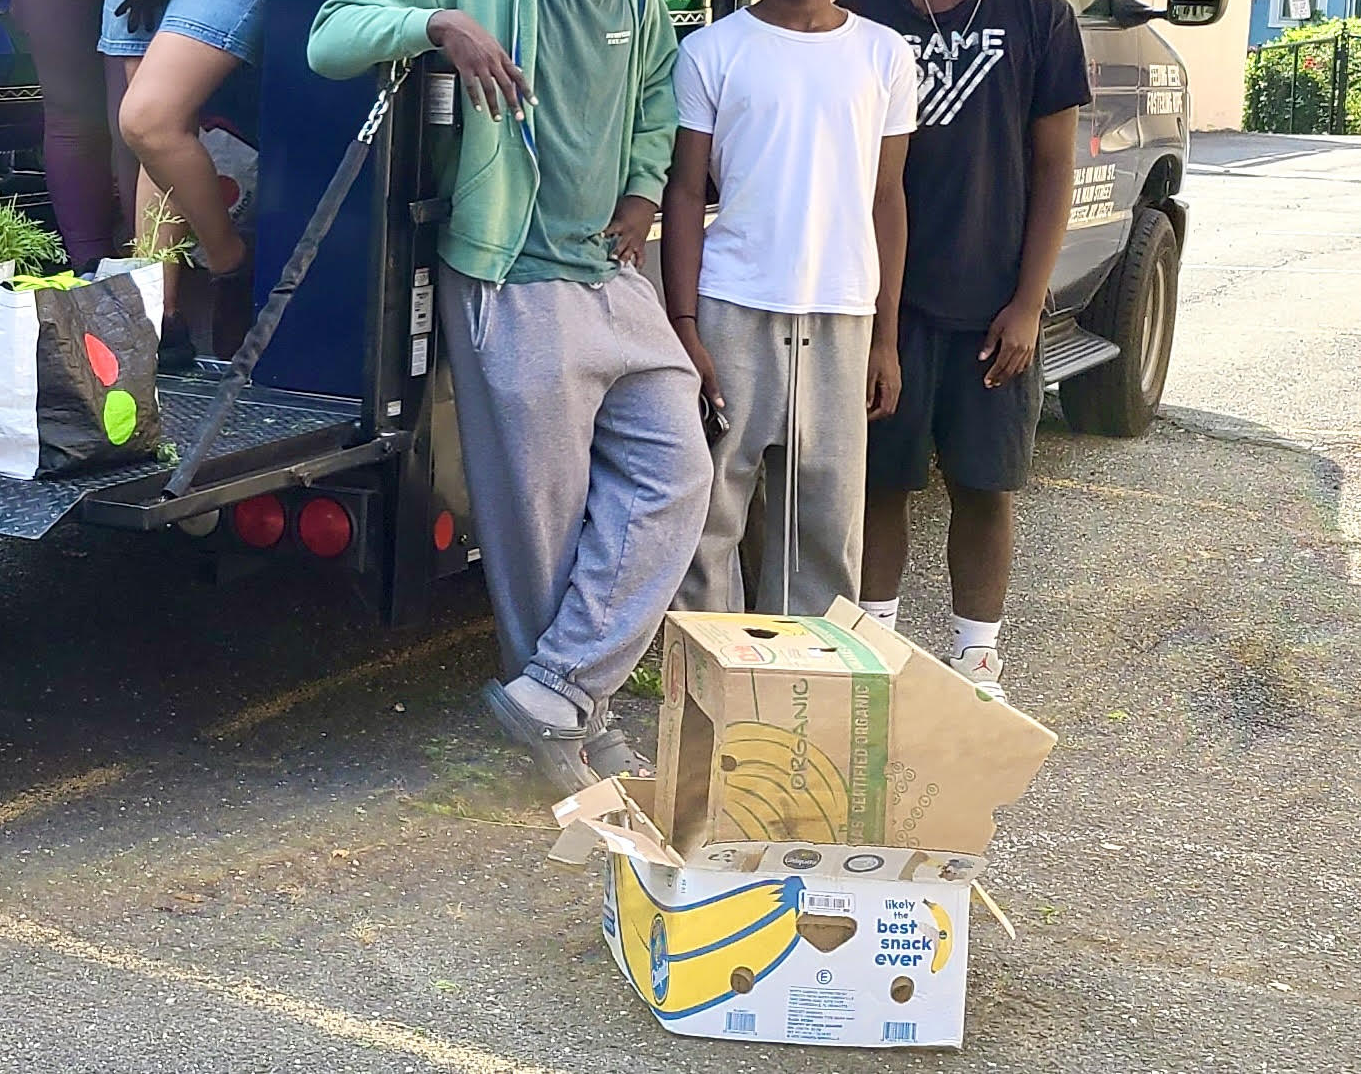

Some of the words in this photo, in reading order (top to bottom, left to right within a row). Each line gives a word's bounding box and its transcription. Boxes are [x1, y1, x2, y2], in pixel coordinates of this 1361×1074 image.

[902, 28, 1006, 61] GAME
[790, 678, 809, 791] ORGANIC
[885, 899, 915, 912] likely
[877, 918, 918, 934] best
[880, 936, 933, 951] snack
[874, 953, 923, 966] ever
